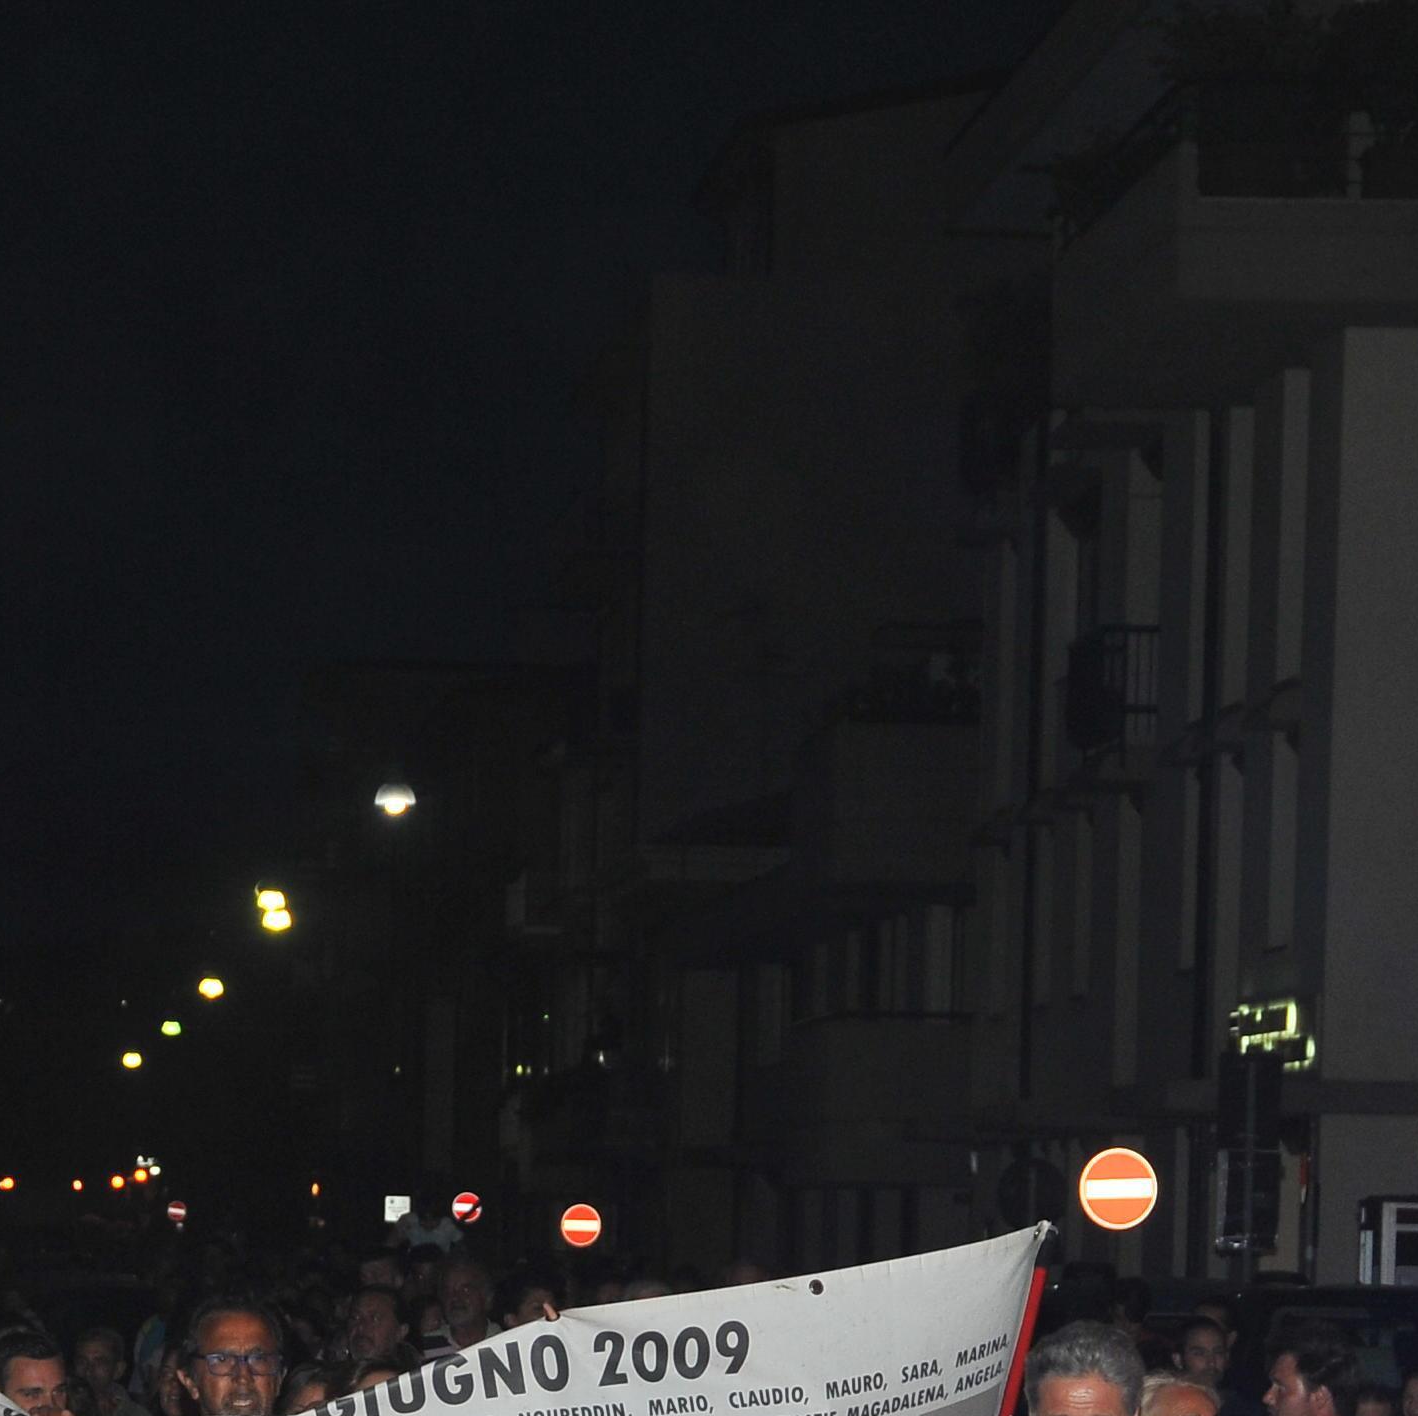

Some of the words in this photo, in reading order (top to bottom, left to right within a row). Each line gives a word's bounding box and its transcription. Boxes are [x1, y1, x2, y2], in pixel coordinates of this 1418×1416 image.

[593, 1320, 750, 1387] 2009
[730, 1386, 810, 1410] CLAUDIO,
[825, 1371, 888, 1400] MAURO,
[901, 1359, 943, 1384] SARA,
